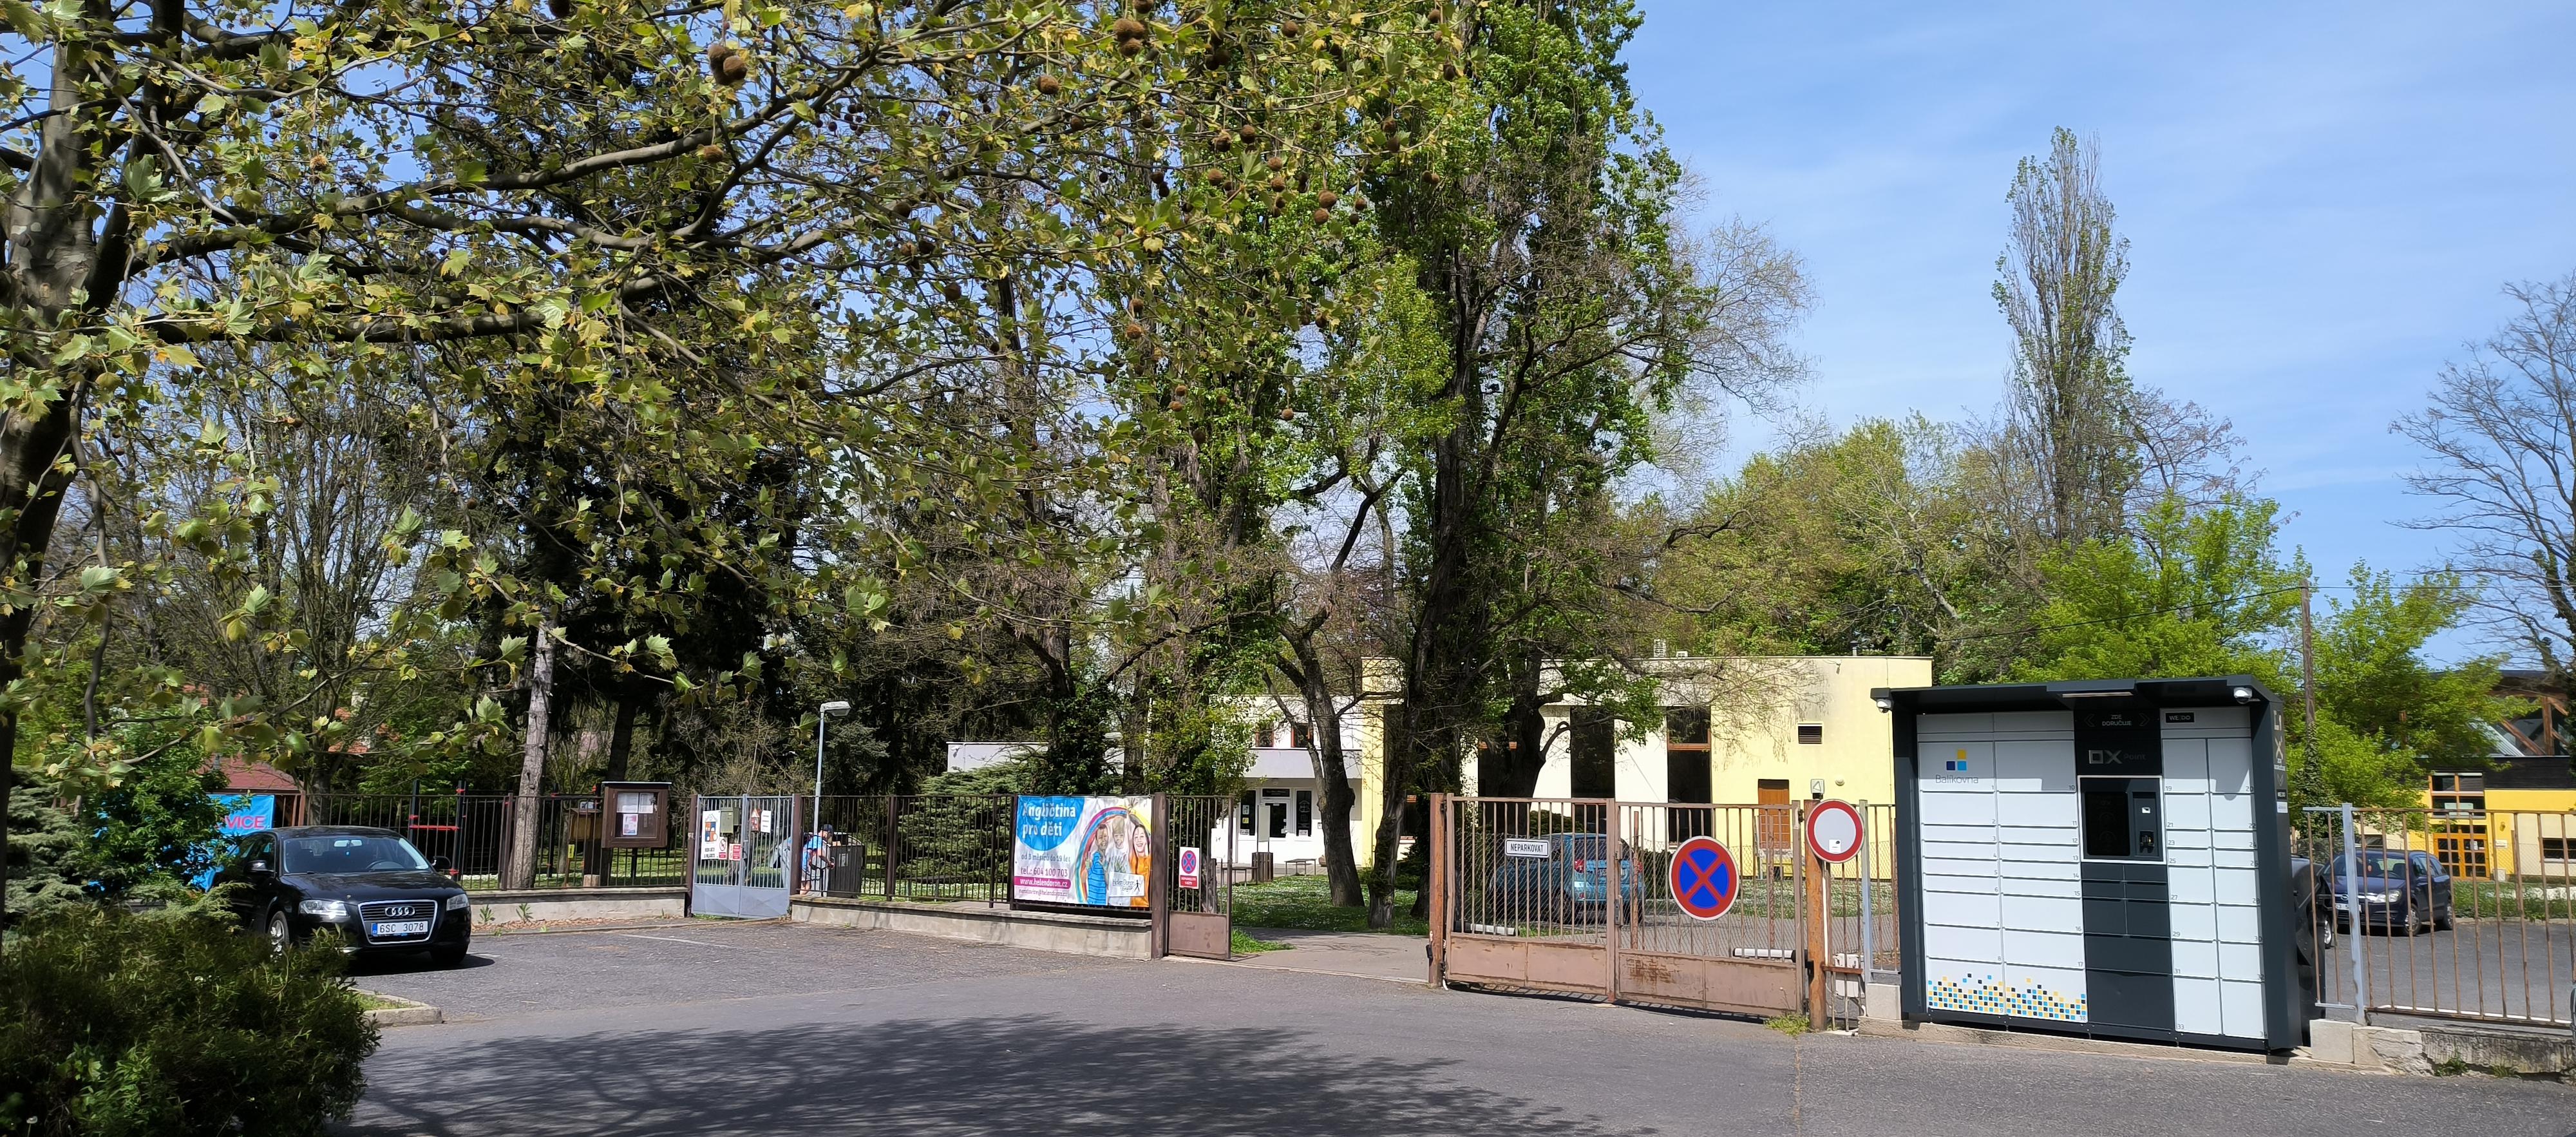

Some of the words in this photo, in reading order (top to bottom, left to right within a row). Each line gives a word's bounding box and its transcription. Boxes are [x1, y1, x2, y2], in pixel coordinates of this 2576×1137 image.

[1935, 774, 1979, 784] Balíkovna
[1023, 802, 1075, 820] Angličtina
[221, 815, 265, 829] VICE
[1023, 825, 1037, 839] pro
[1041, 821, 1062, 836] děti
[1510, 843, 1544, 853] NEPARKOVAT
[1021, 866, 1032, 875] tel.:
[1046, 868, 1056, 877] 100
[1020, 878, 1068, 887] www.helendoron.cz
[380, 924, 396, 933] 6SC
[403, 922, 423, 932] 3078
